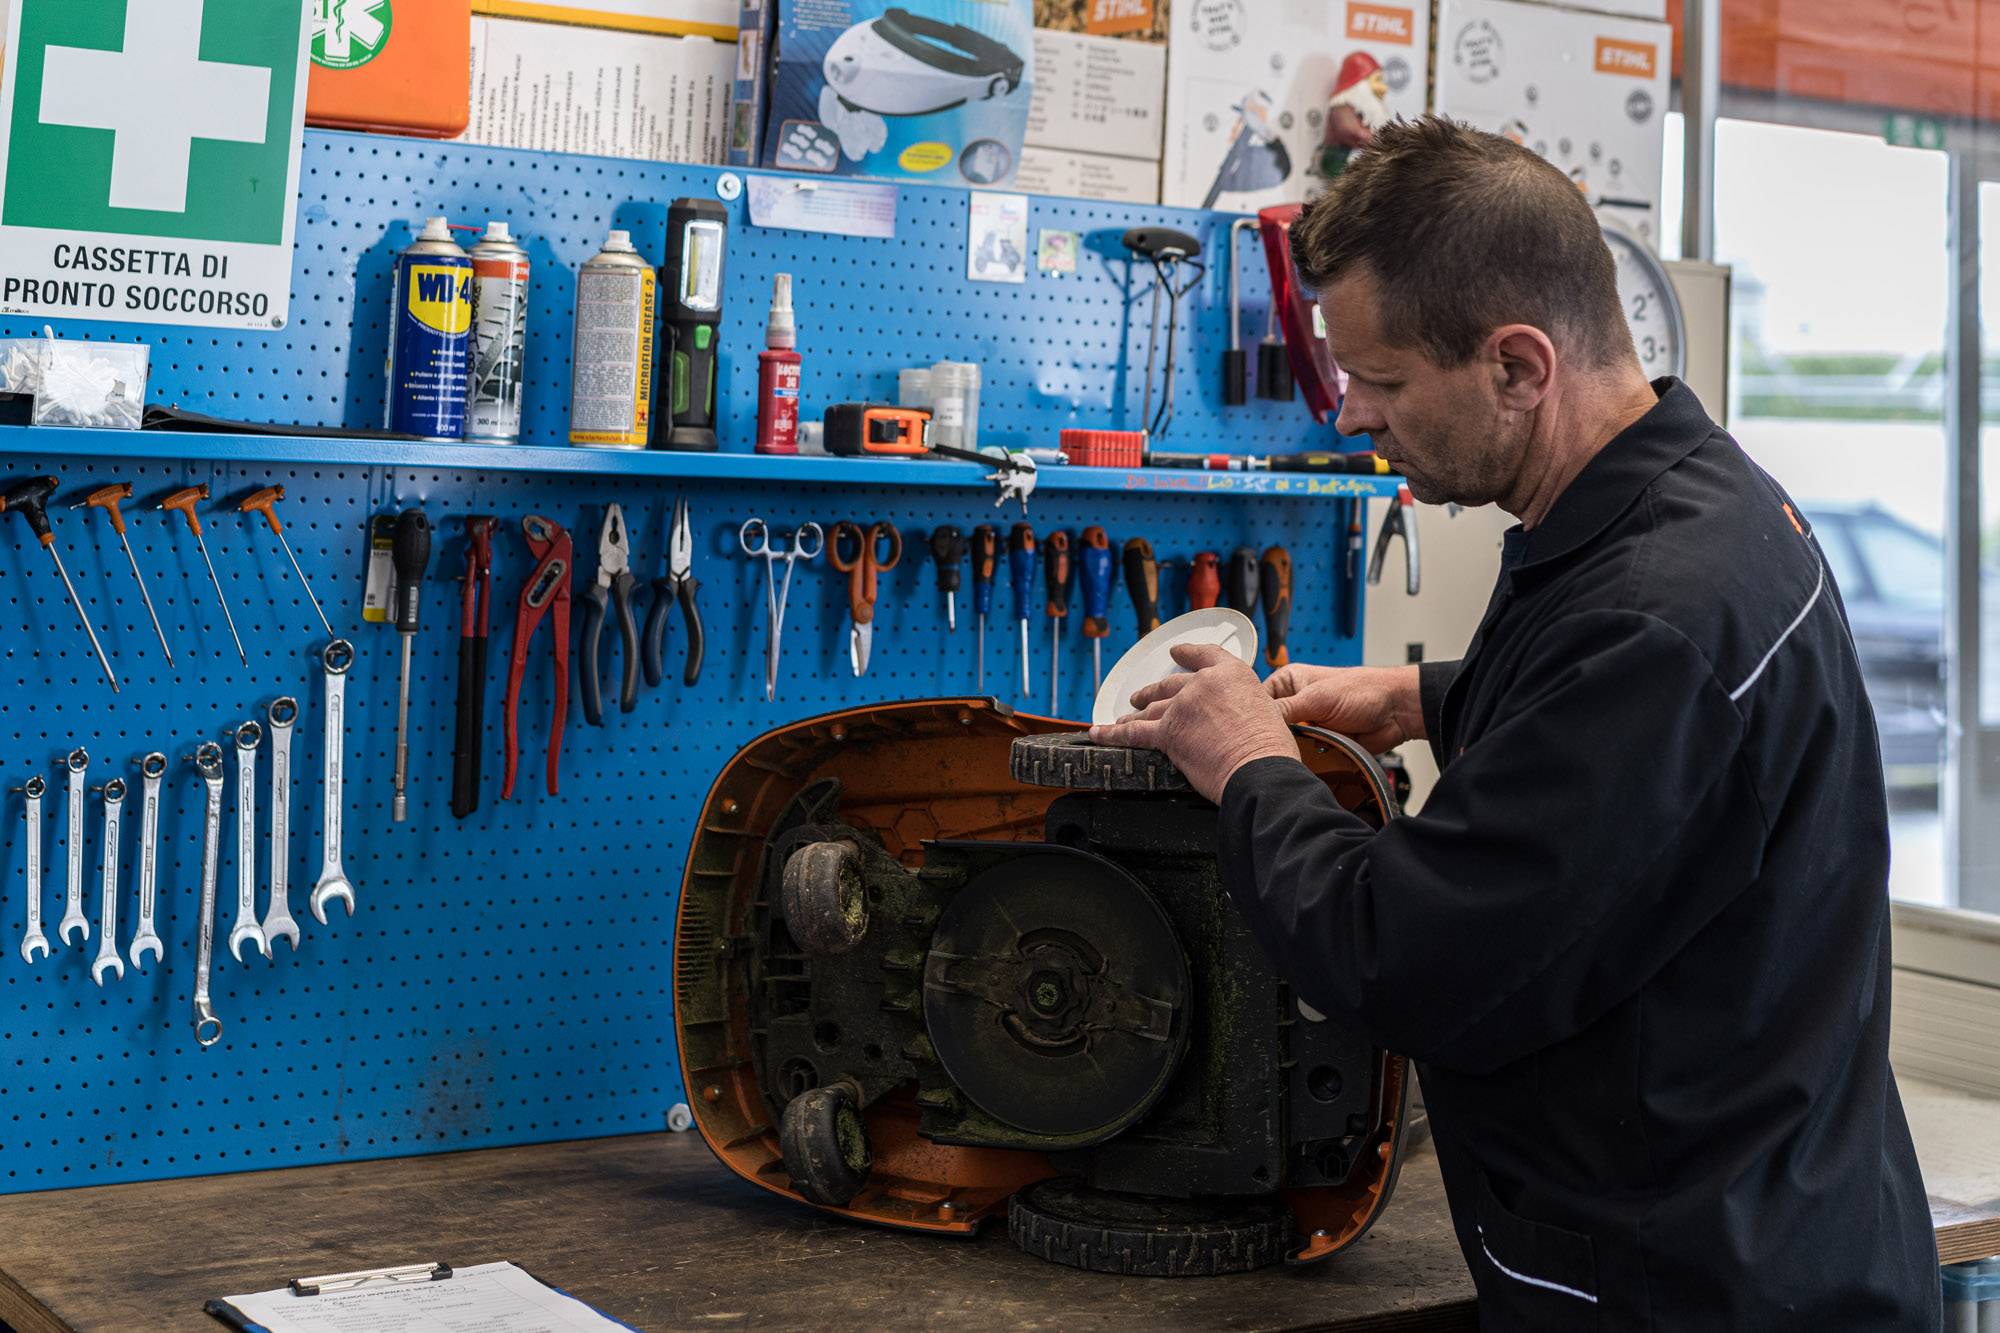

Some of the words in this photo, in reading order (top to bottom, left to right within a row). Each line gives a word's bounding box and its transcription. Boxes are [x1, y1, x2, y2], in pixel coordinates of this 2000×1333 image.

[1353, 12, 1408, 37] STIHL
[1601, 47, 1651, 70] STIHL
[53, 244, 191, 277] CASSETTA
[202, 254, 228, 279] DI
[3, 277, 115, 309] PRONTO
[125, 285, 269, 317] SOCCORSO
[417, 272, 471, 304] WD-4
[1633, 295, 1647, 321] 2
[1642, 337, 1656, 362] 3
